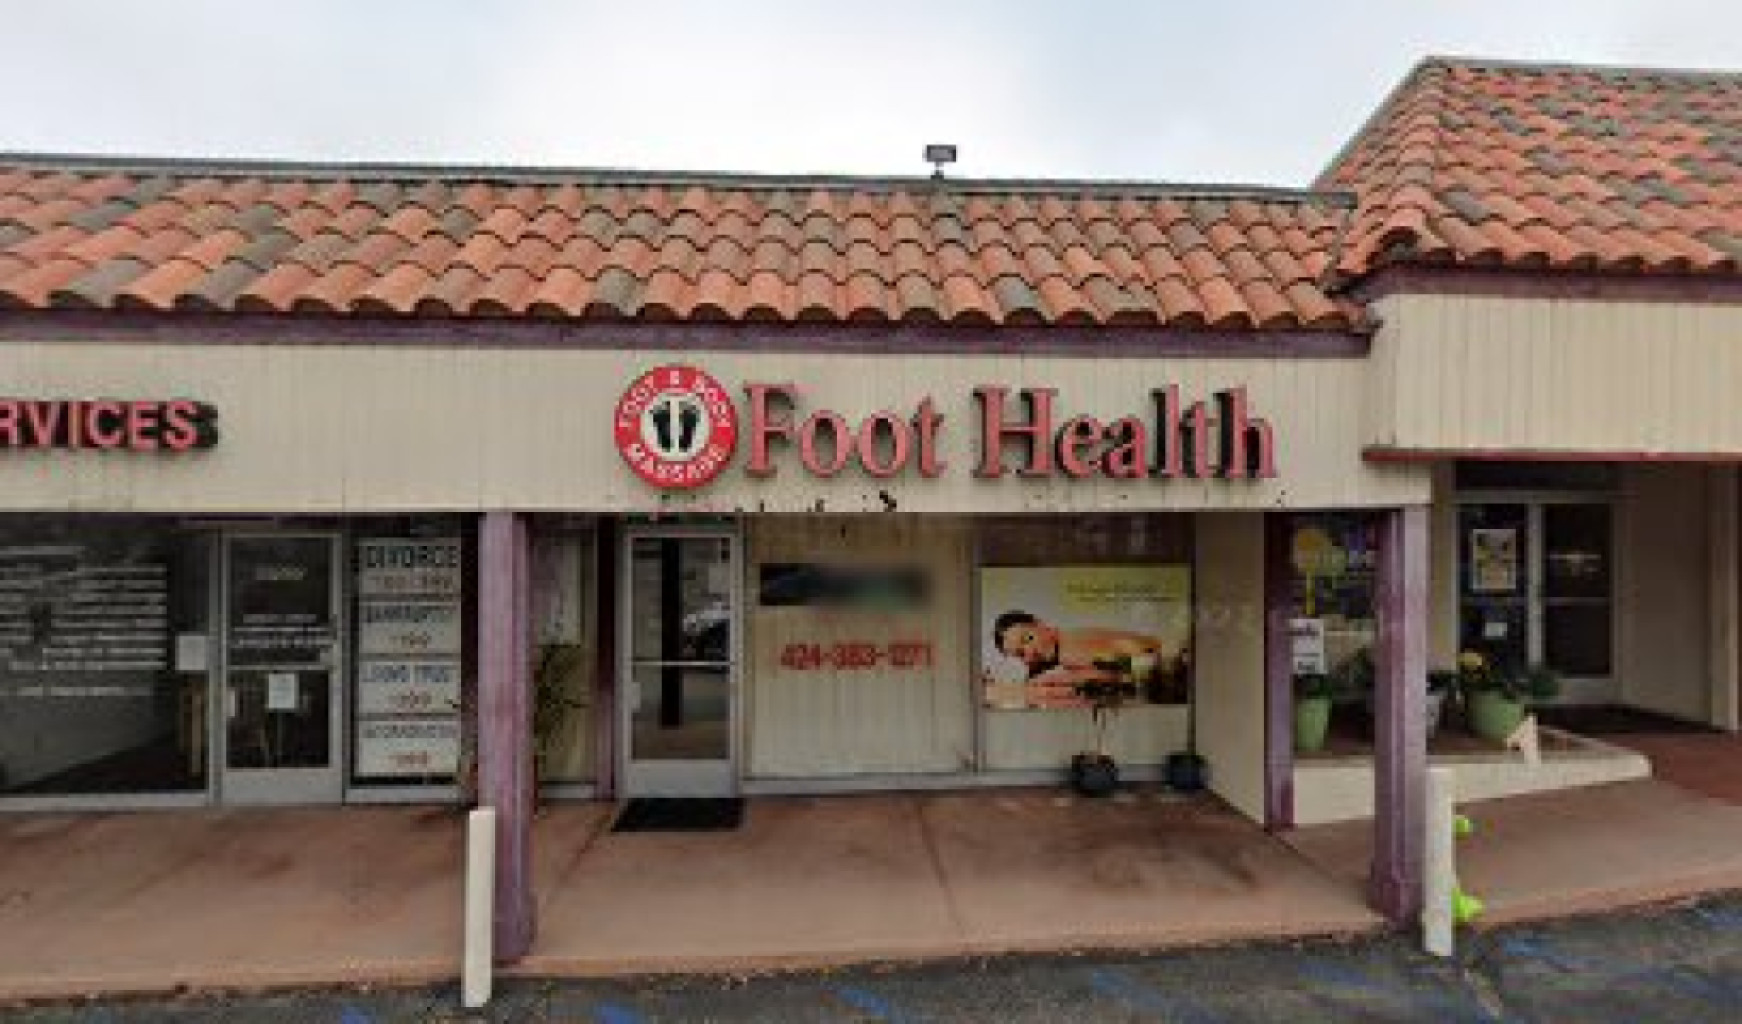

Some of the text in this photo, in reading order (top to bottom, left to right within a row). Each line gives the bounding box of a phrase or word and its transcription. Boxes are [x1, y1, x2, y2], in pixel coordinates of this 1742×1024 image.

[744, 383, 1276, 480] Foot Health
[366, 544, 458, 568] DIVORCE
